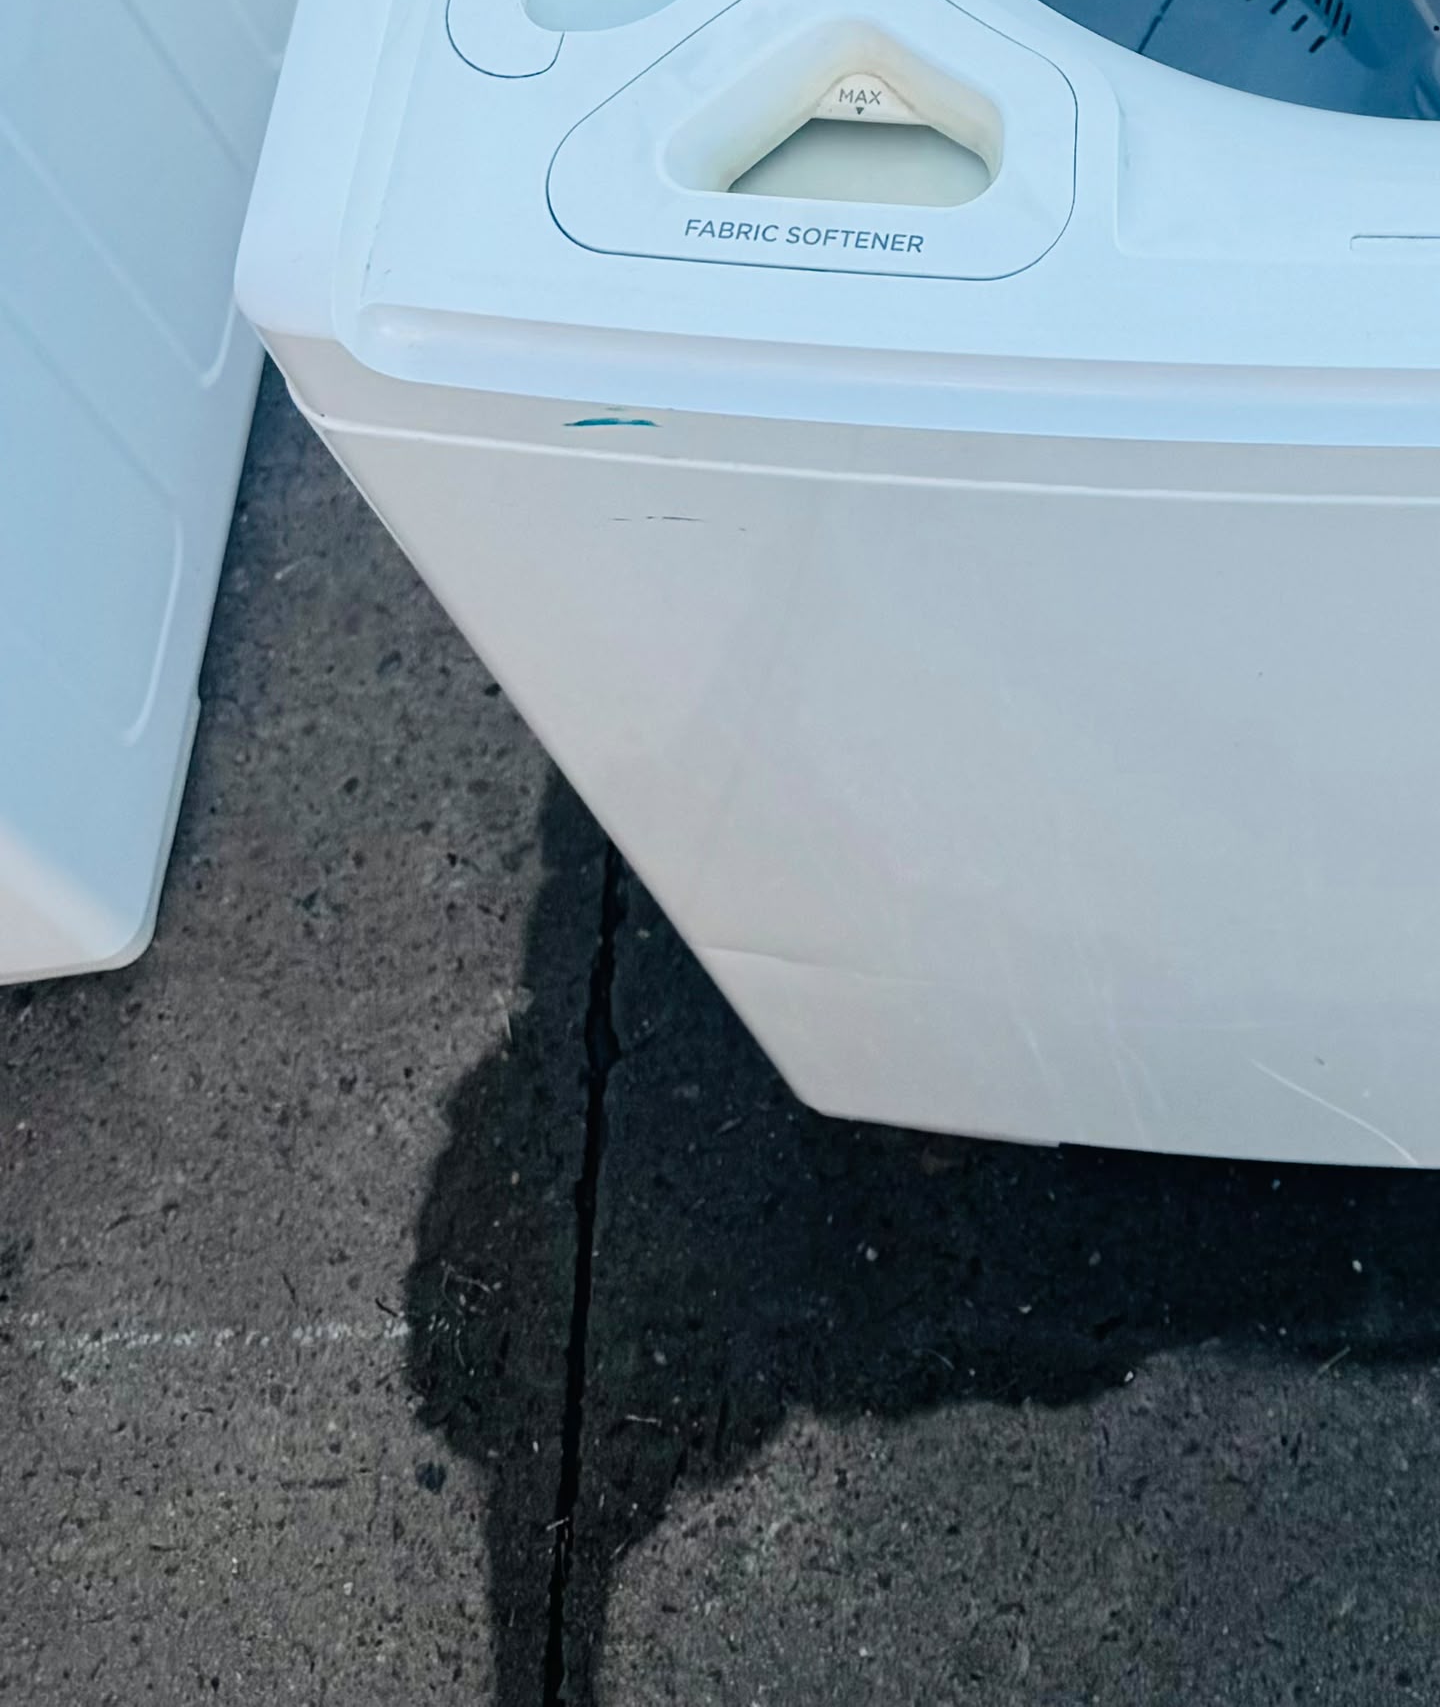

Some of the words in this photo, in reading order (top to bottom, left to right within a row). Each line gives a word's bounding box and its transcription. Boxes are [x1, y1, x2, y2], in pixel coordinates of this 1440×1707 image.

[838, 88, 882, 105] MAX
[684, 219, 779, 243] FABRIC
[785, 226, 925, 253] SOFTENER
